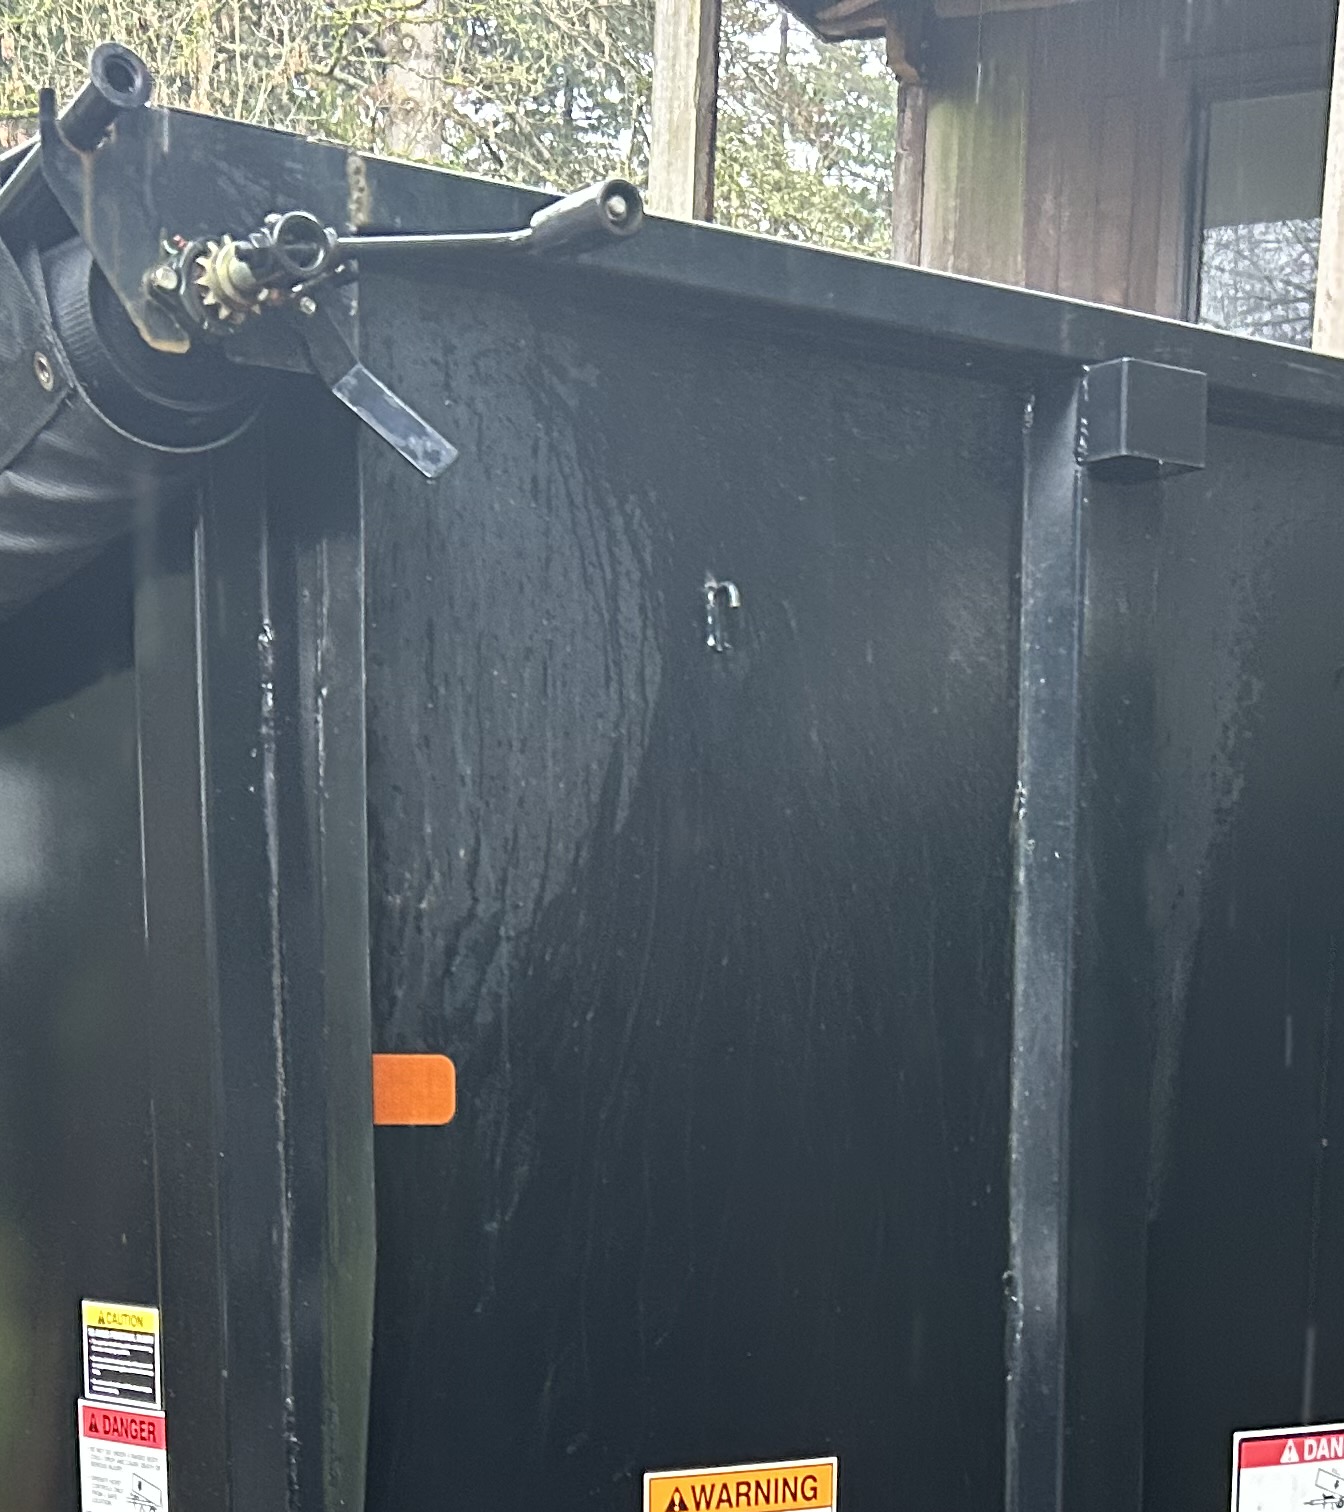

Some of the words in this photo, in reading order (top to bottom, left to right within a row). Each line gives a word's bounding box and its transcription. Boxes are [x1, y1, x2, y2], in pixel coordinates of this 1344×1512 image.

[106, 1311, 144, 1328] CAUTION
[102, 1414, 157, 1443] DANGER
[690, 1474, 818, 1512] WARNING
